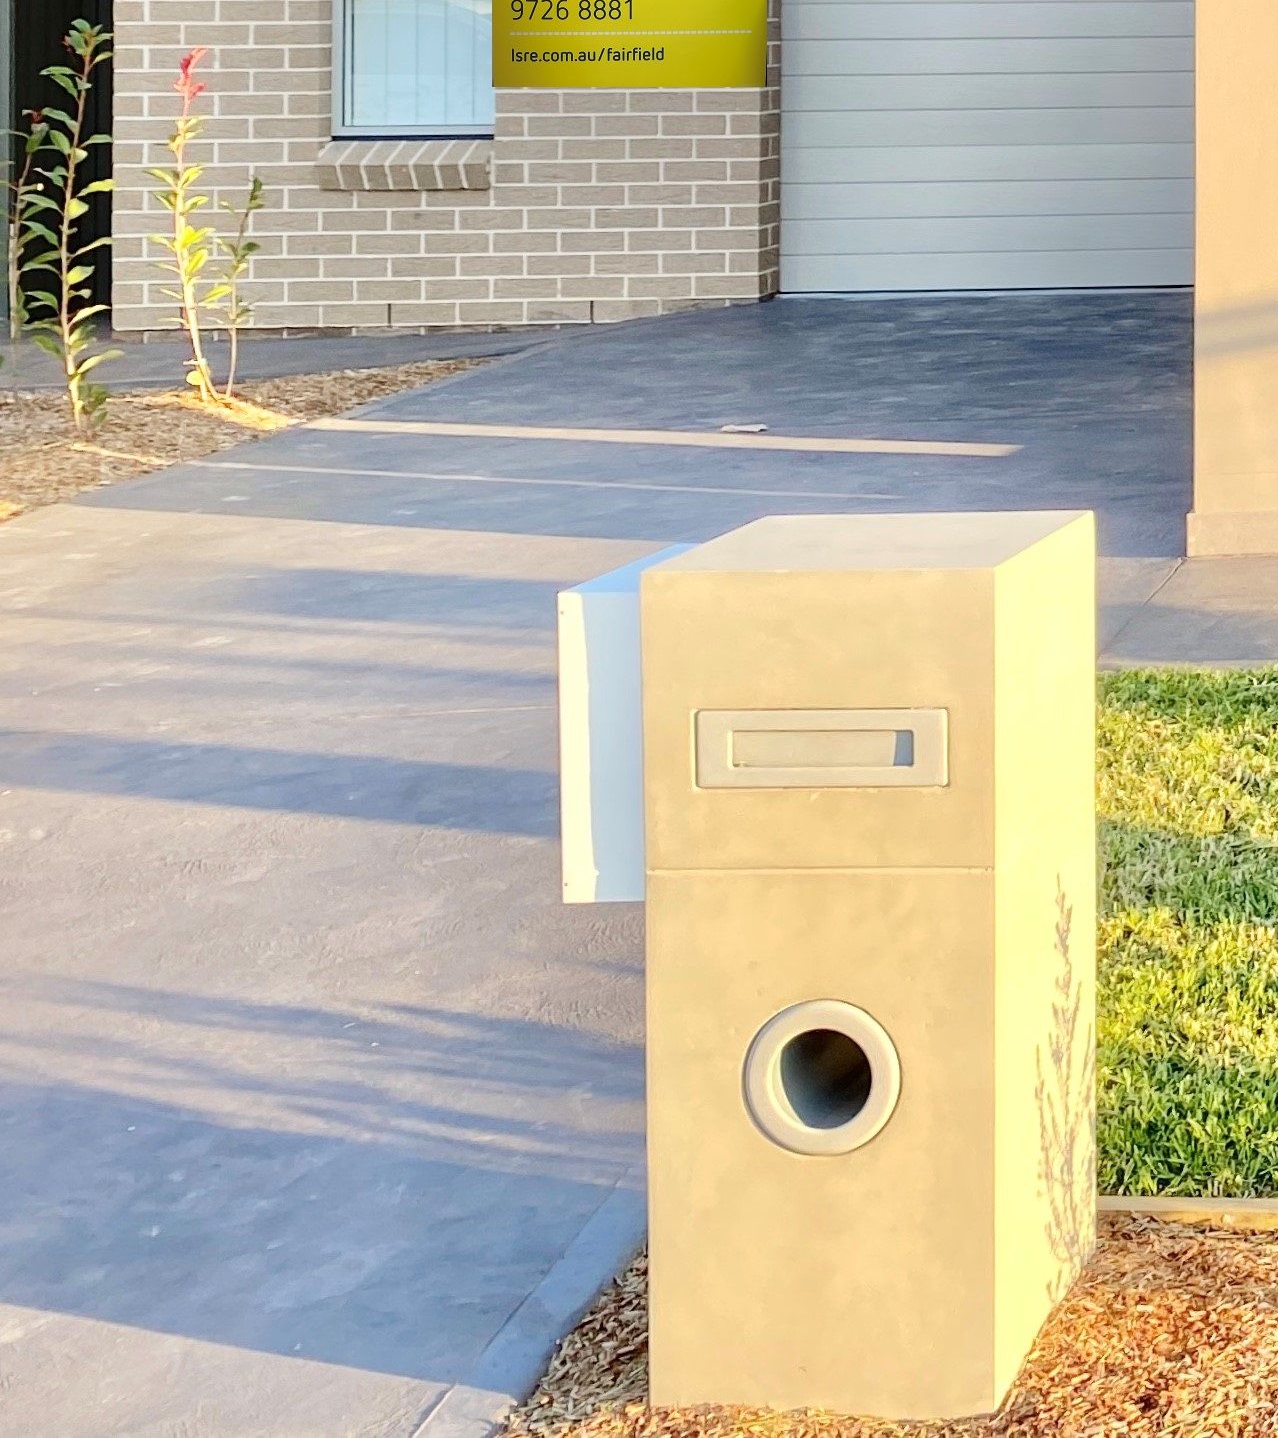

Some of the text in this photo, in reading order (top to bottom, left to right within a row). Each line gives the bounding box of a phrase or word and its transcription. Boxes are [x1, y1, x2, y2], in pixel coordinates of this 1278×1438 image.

[511, 0, 633, 20] 9726 8881
[511, 47, 664, 63] lsre.com.au/fairfield
